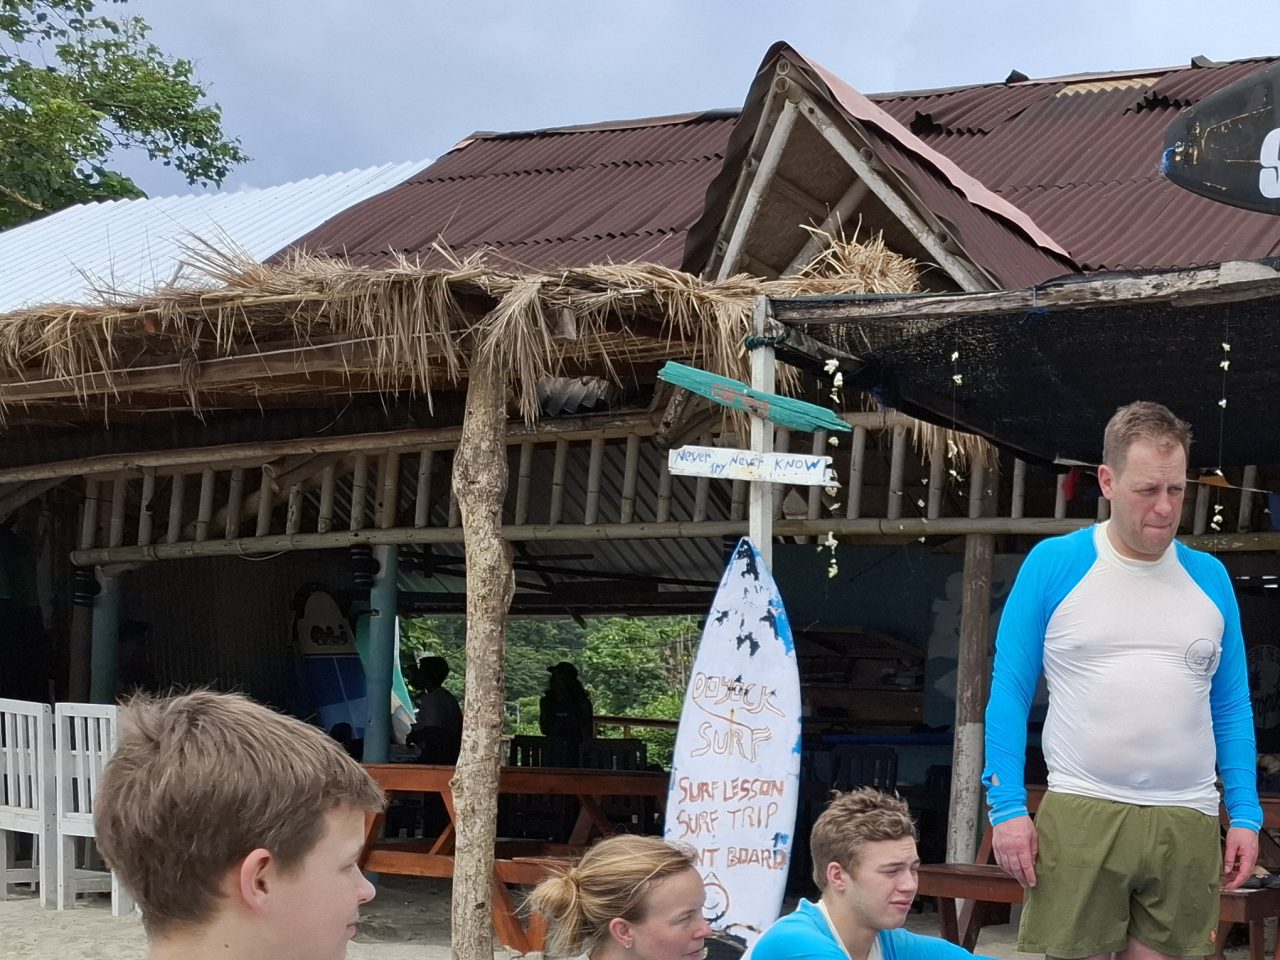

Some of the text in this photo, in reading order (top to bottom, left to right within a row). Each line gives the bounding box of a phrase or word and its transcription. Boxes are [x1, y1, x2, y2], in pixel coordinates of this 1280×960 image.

[674, 450, 712, 465] Never
[691, 721, 773, 763] SURF
[678, 776, 784, 804] SURF LESSON
[676, 802, 779, 839] SURF TRIP
[727, 846, 788, 871] BOARD
